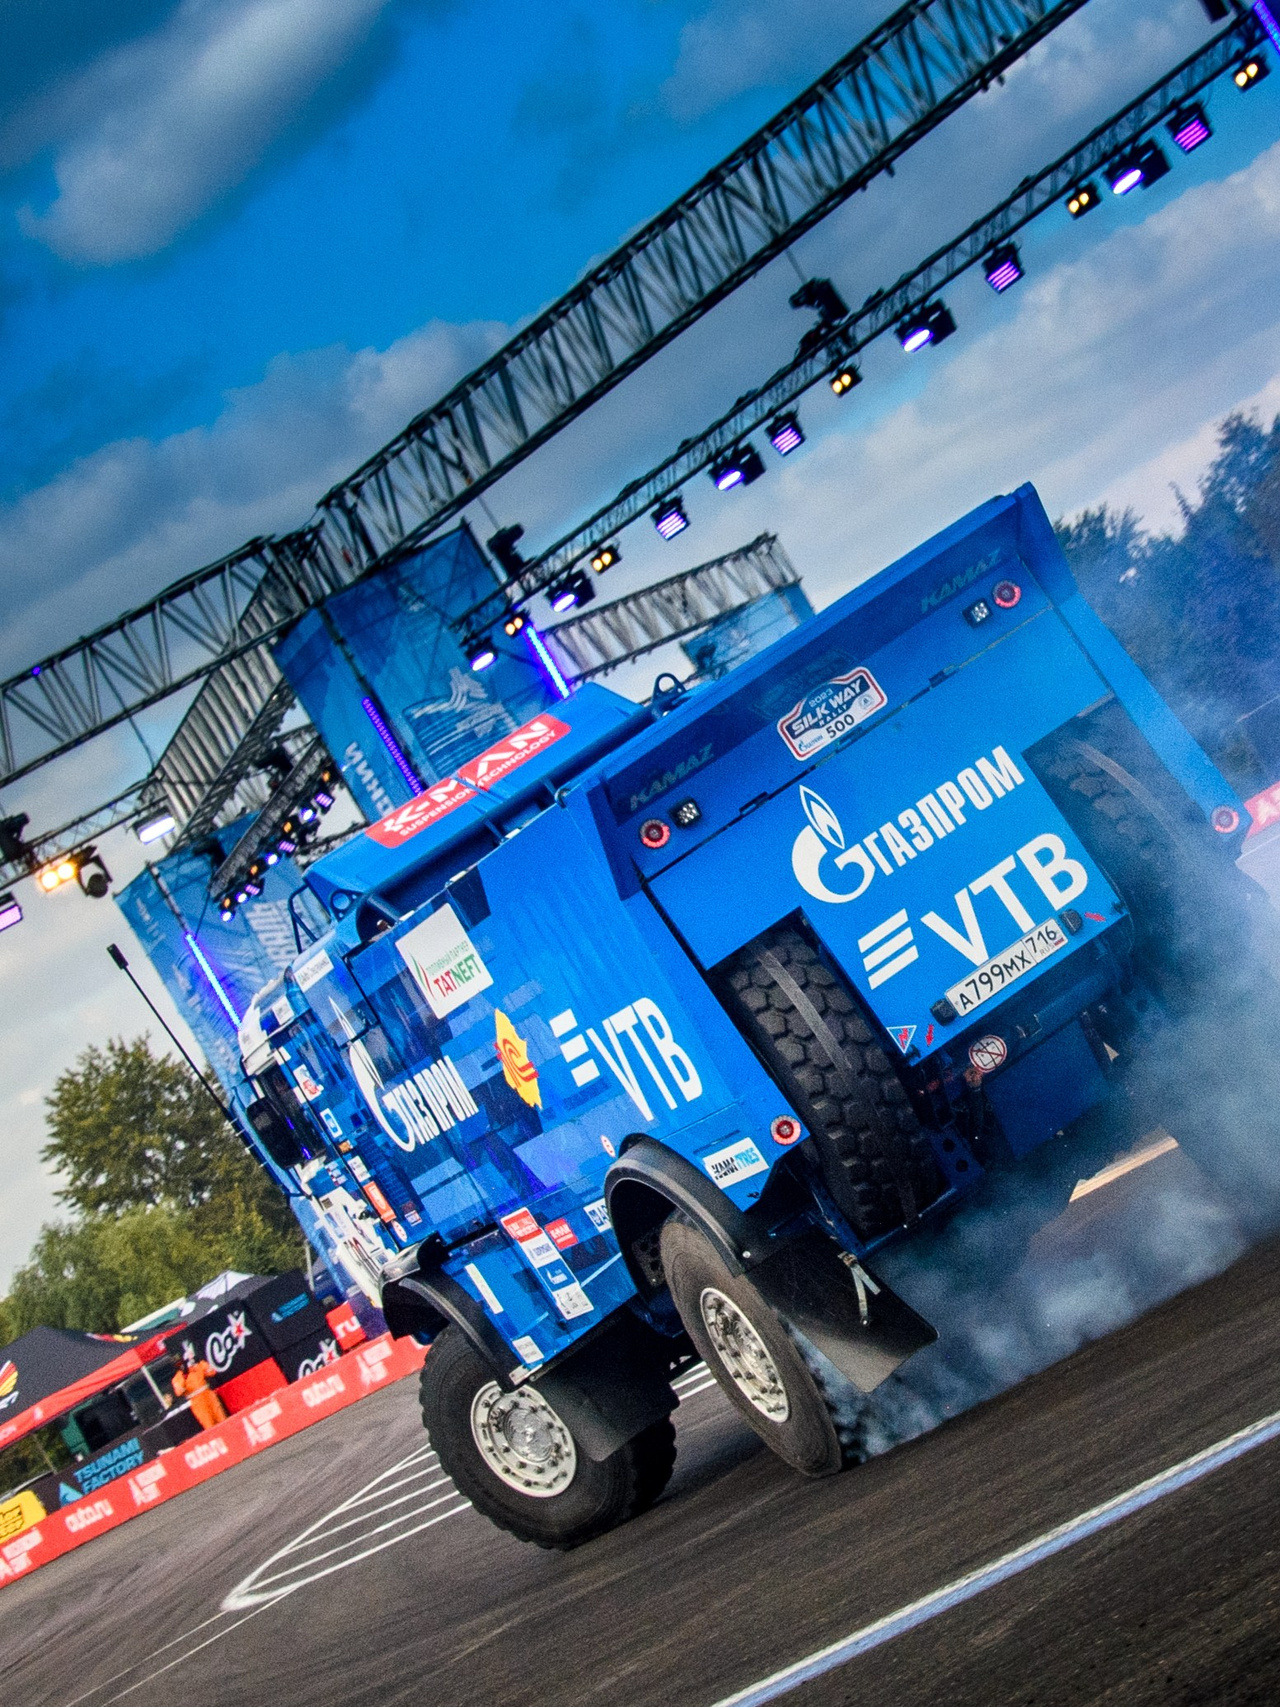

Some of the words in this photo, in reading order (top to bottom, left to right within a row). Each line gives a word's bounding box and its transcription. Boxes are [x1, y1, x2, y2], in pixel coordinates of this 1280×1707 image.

[921, 547, 1001, 614] KAMAZ
[791, 702, 830, 736] SILK
[828, 678, 861, 709] WAY
[808, 688, 834, 708] 2023
[825, 713, 855, 739] 500
[399, 785, 474, 836] SUSPENSION
[477, 730, 556, 787] TECHNOLOGY
[630, 742, 714, 811] KAMAZ
[862, 745, 1025, 876] ГАЗПРОМ
[920, 833, 1089, 967] VTB
[1025, 925, 1057, 953] 716
[1039, 943, 1055, 957] RUS
[433, 953, 481, 997] TATNEFT
[586, 997, 703, 1121] VTB
[73, 1437, 142, 1484] TSUNAMI
[82, 1449, 145, 1495] FACTORY
